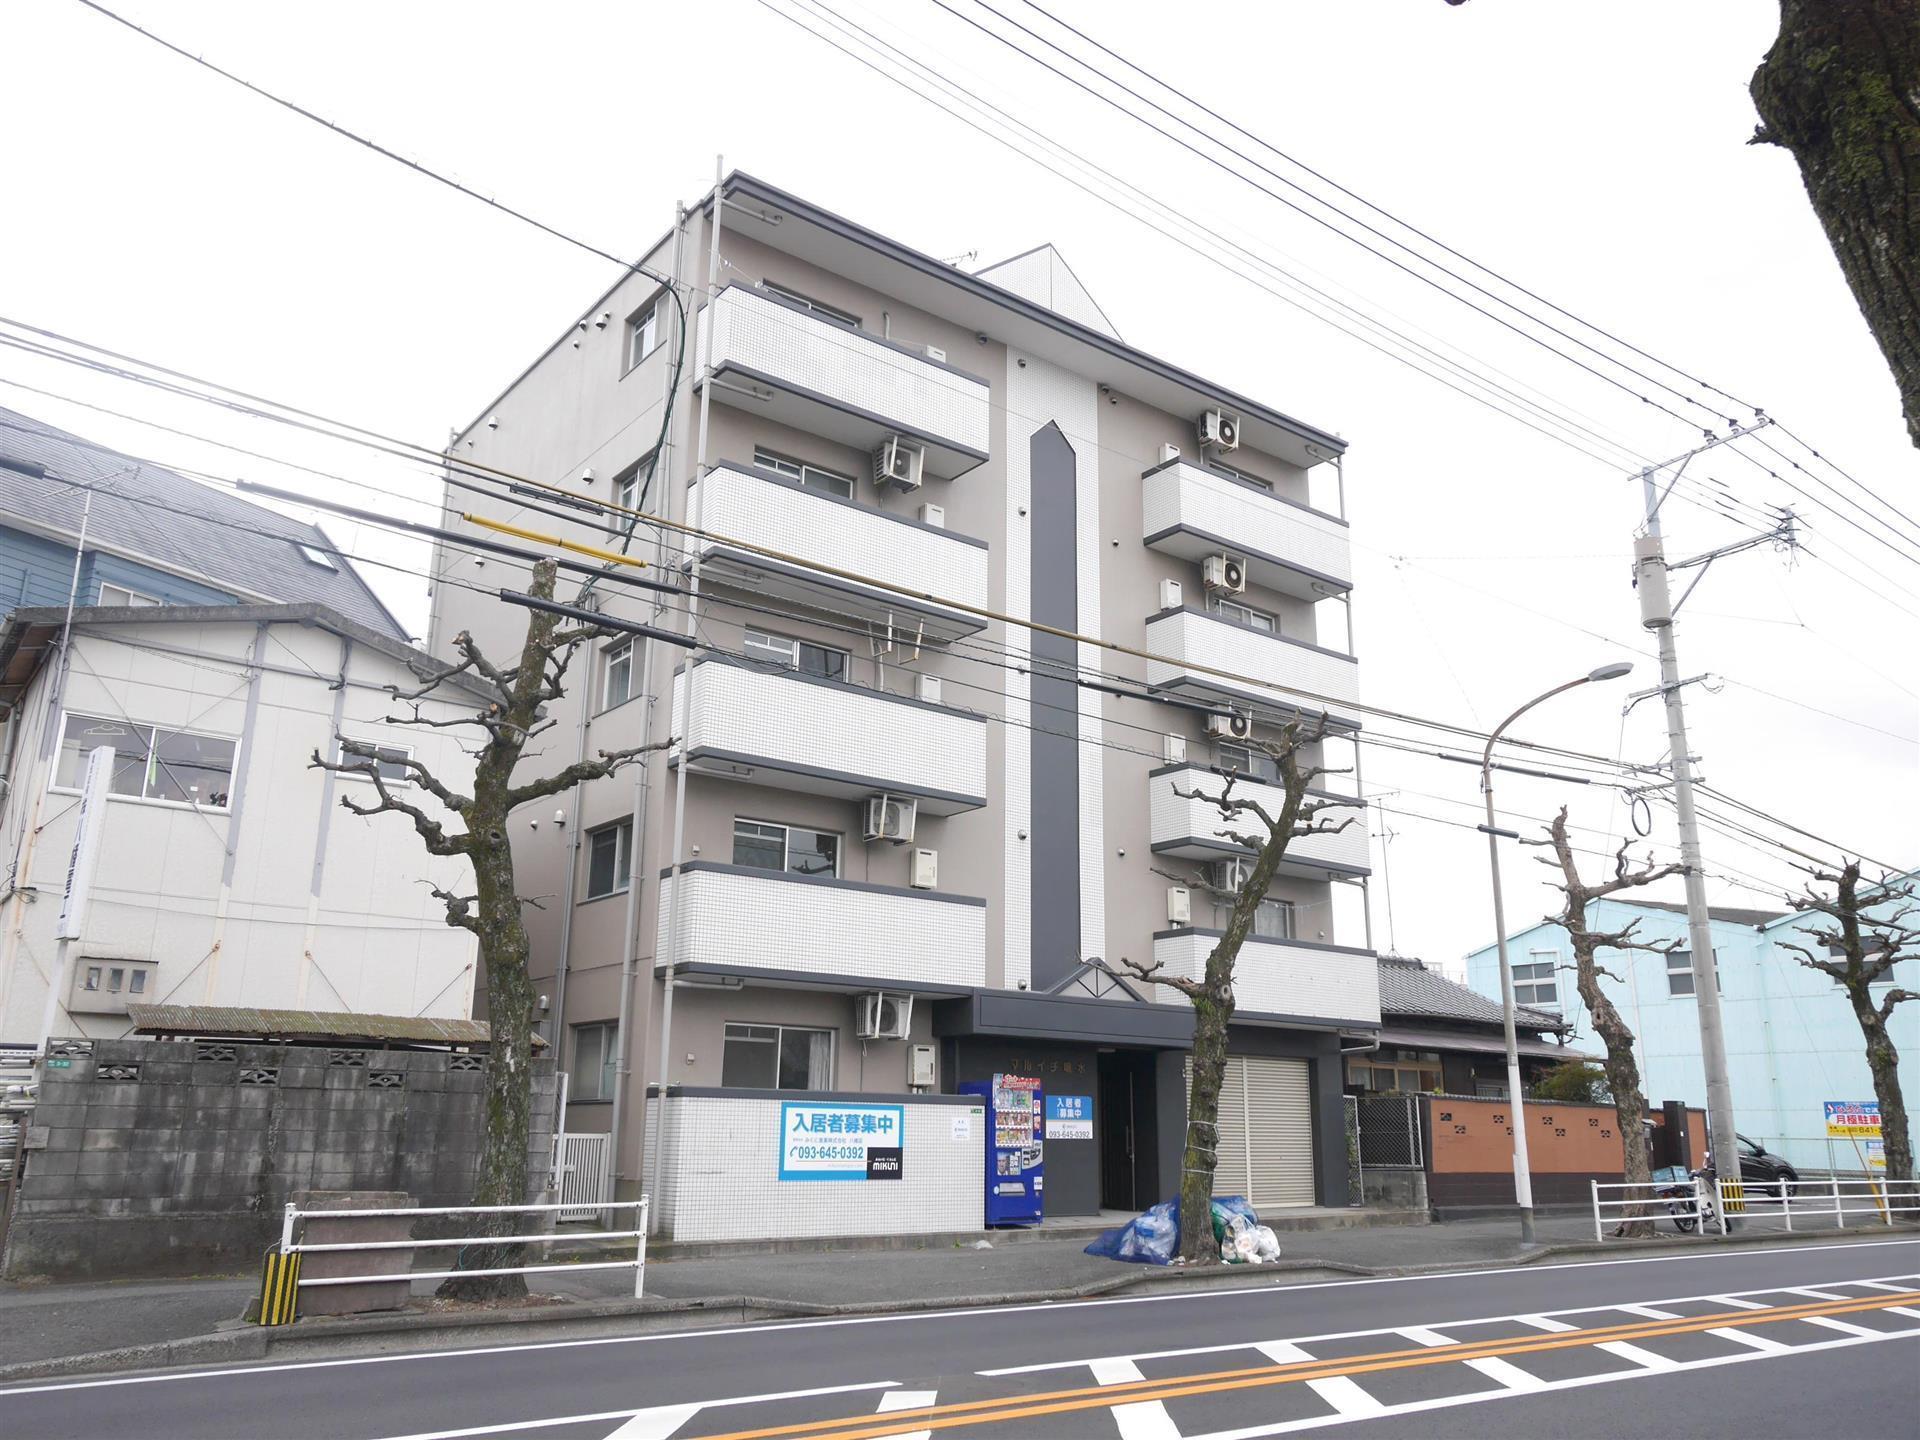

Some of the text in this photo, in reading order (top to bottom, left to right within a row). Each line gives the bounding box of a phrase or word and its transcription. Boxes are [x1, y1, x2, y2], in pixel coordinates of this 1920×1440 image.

[1056, 1097, 1082, 1108] 入居者
[1059, 1108, 1082, 1119] 募集中
[792, 1113, 893, 1134] 入居者募集中
